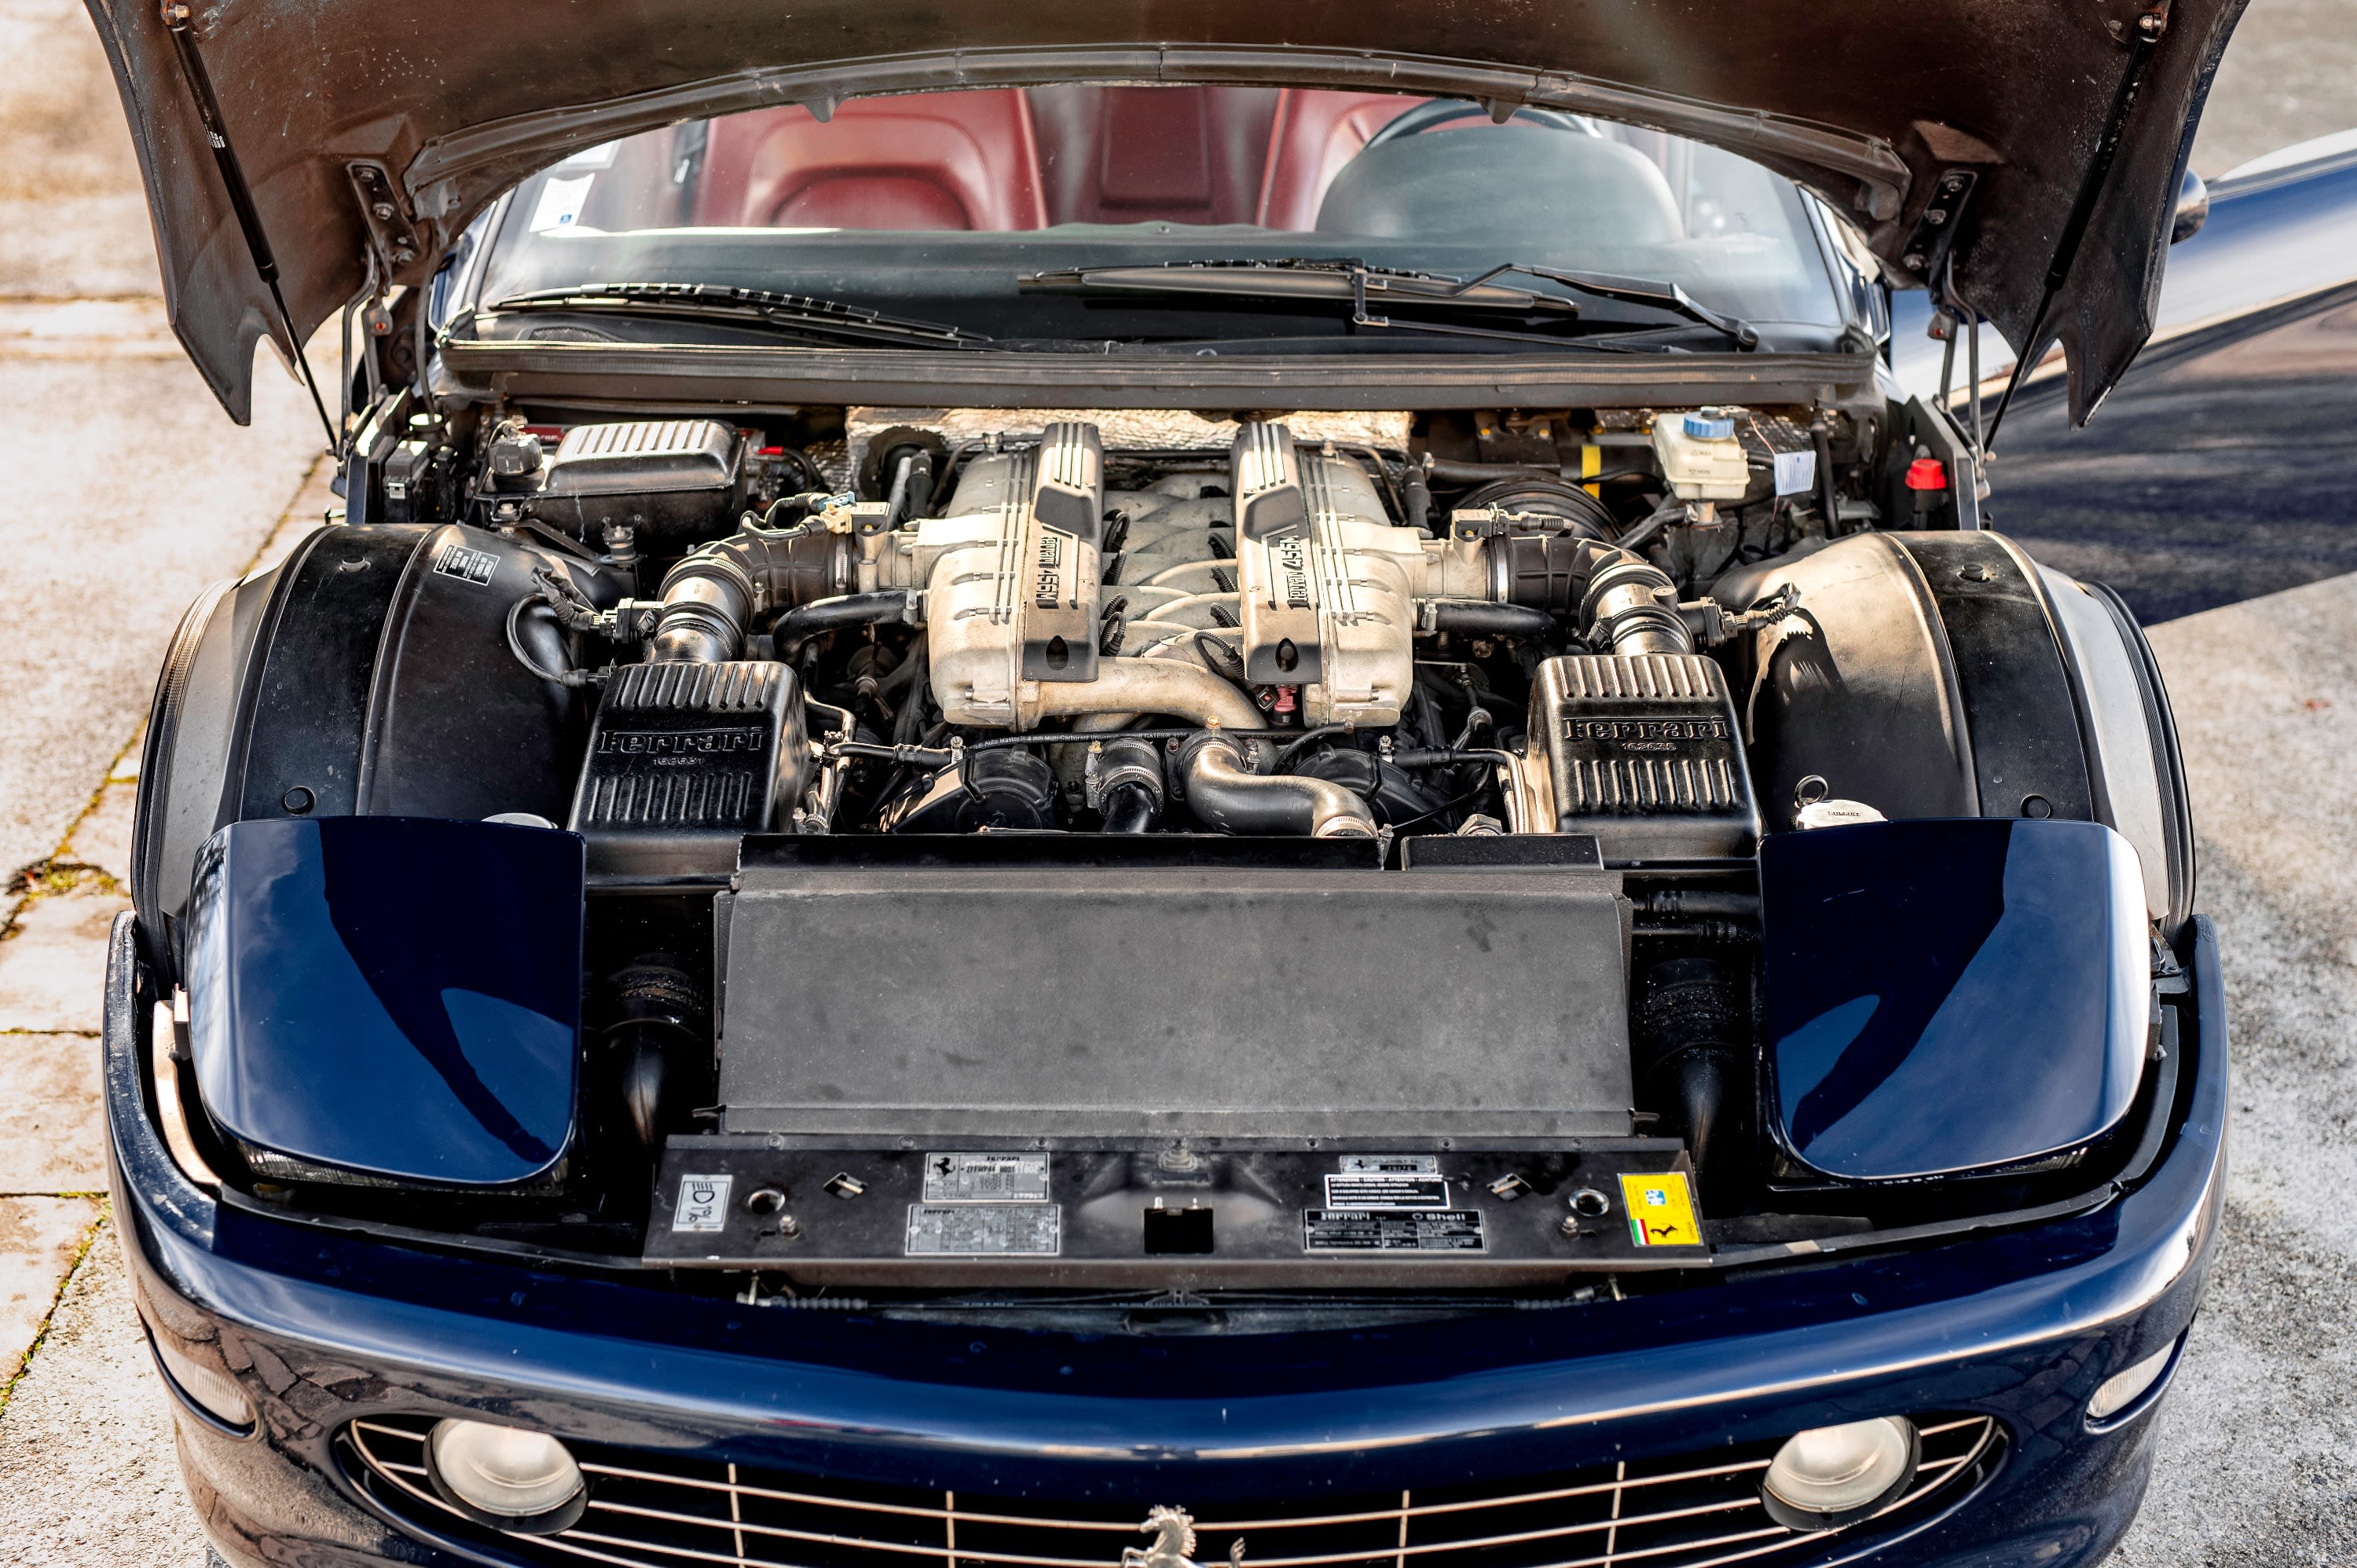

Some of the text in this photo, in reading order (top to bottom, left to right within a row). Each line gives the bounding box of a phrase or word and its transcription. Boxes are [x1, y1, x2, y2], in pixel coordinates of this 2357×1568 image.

[1280, 536, 1303, 571] 456M
[1036, 570, 1059, 606] 456M
[598, 727, 764, 753] Ferrari
[1563, 716, 1728, 740] Ferrari
[984, 738, 999, 747] Auto
[654, 757, 704, 765] 162631
[1321, 1212, 1370, 1221] Ferrari
[1426, 1212, 1466, 1221] Shell
